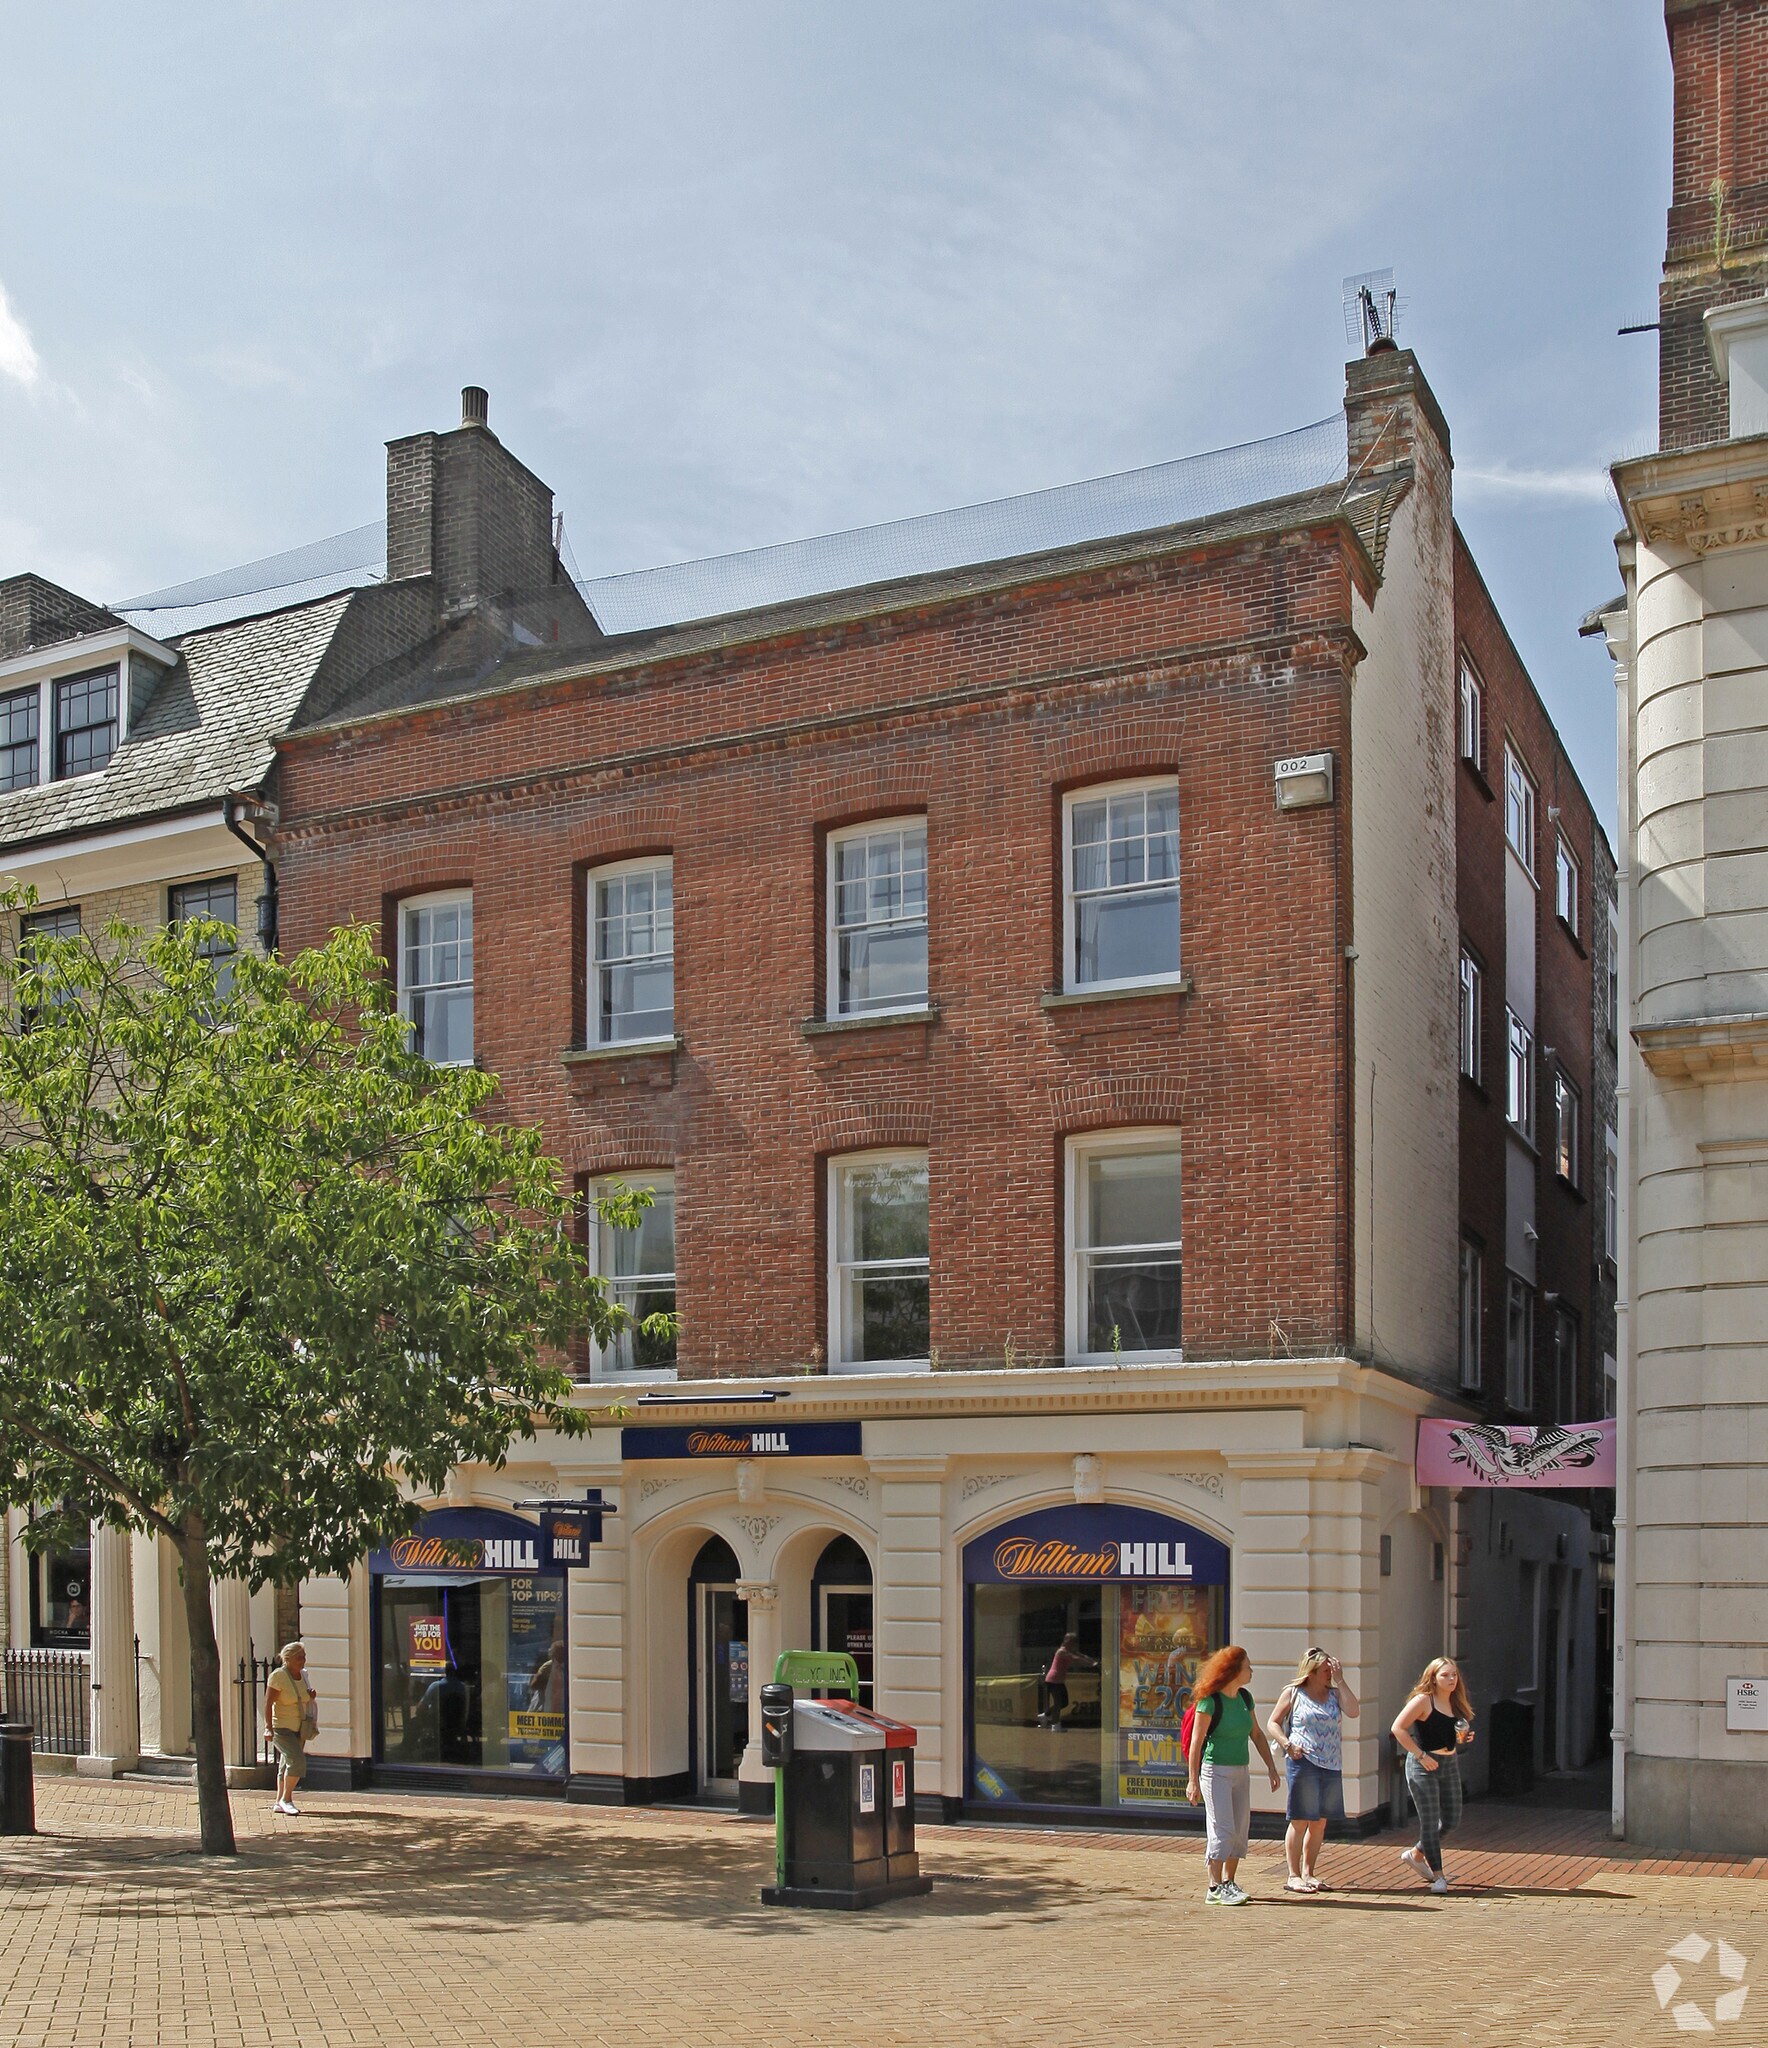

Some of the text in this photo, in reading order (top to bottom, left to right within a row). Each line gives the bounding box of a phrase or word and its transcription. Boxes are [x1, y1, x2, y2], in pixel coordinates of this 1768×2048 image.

[1281, 760, 1307, 772] 002
[687, 1431, 789, 1454] William HILL
[389, 1535, 539, 1570] Will HILL
[553, 1538, 582, 1560] HILL
[993, 1536, 1193, 1579] William HILL
[511, 1578, 533, 1590] FOR
[511, 1590, 563, 1602] TOP TIPS?
[1132, 1589, 1197, 1613] FREE
[429, 1624, 441, 1632] THE
[413, 1637, 442, 1651] YOU
[1133, 1660, 1198, 1686] WIN
[517, 1715, 535, 1726] MEET
[1141, 1733, 1164, 1742] YOUR
[1127, 1777, 1145, 1787] FREE
[1126, 1787, 1163, 1796] SATURDAY
[1164, 1788, 1171, 1797] &
